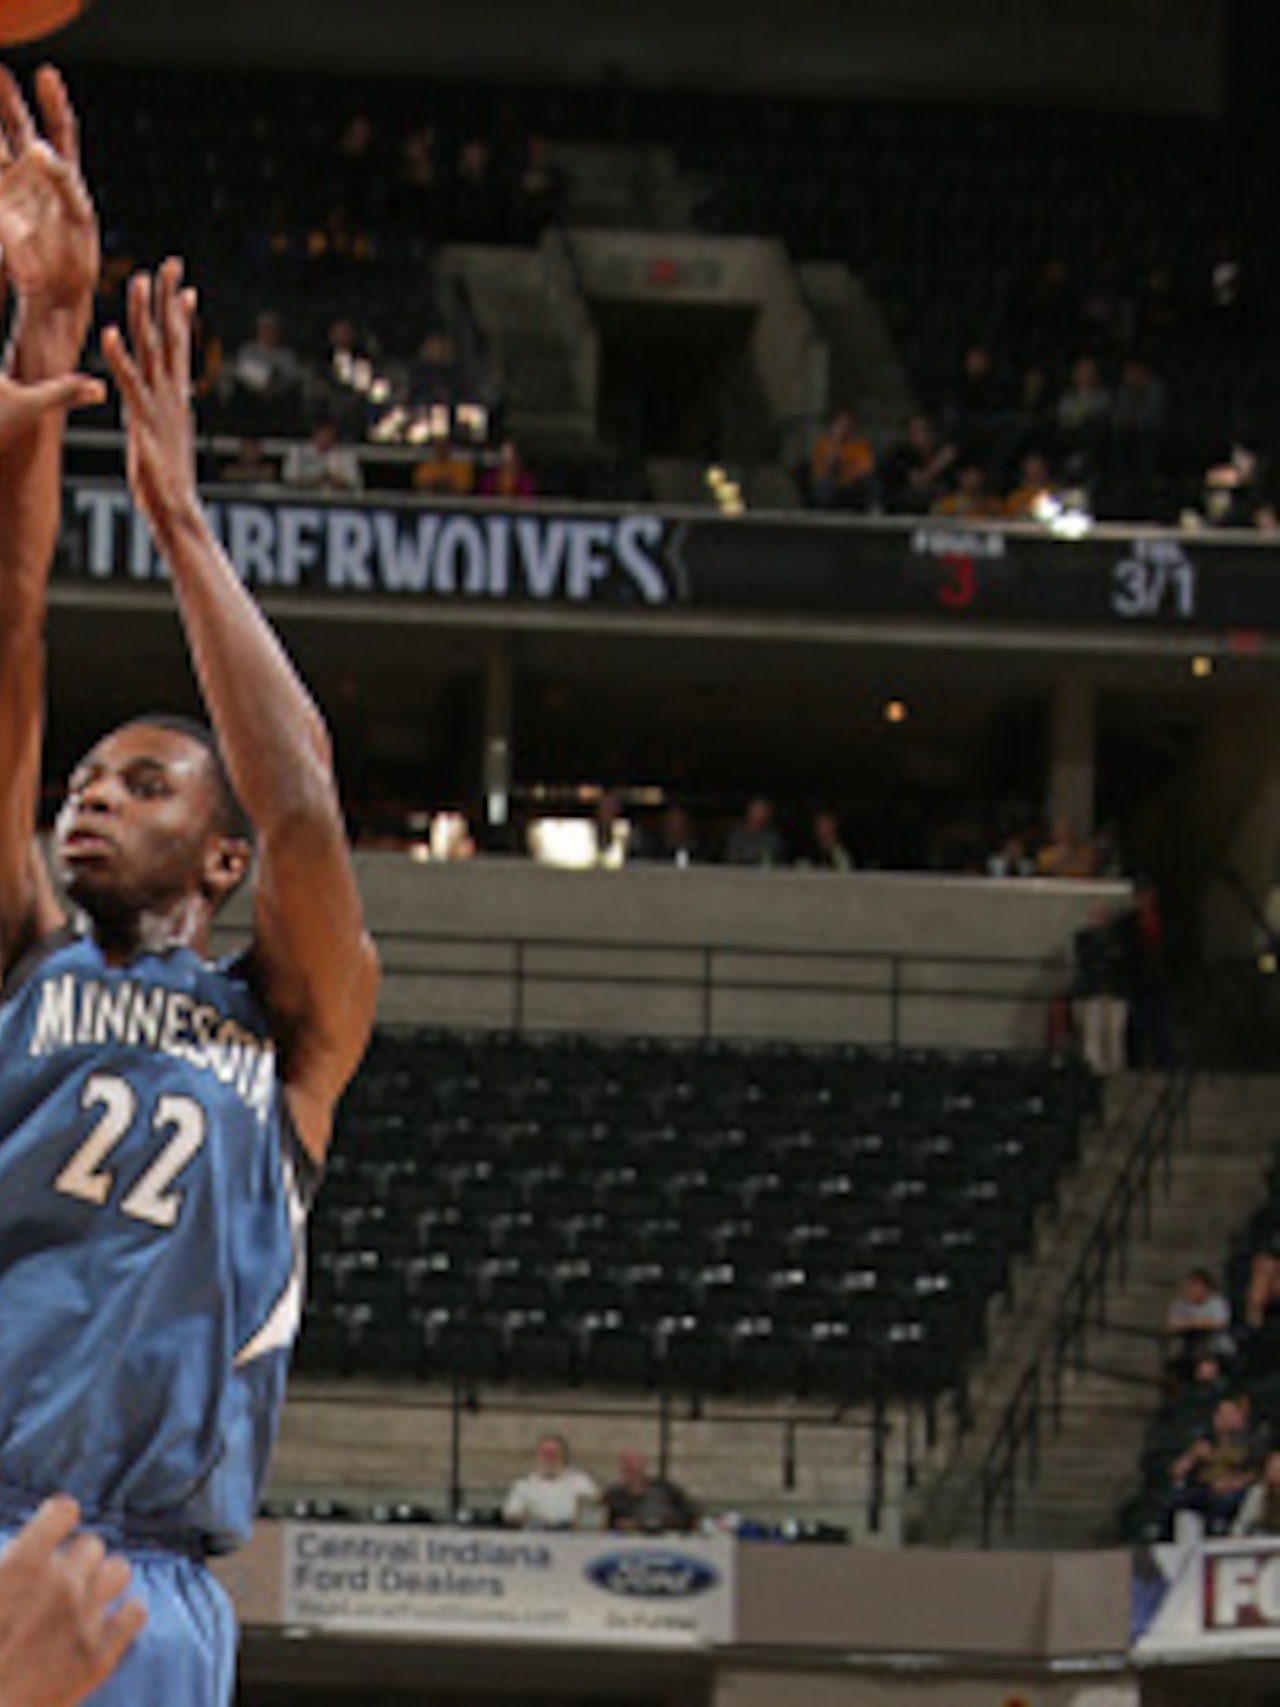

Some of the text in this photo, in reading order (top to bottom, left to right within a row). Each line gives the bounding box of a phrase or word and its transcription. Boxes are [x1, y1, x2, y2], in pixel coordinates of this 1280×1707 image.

[76, 491, 667, 604] TIBERWOLVES
[940, 553, 978, 609] 3
[1111, 558, 1195, 618] 3/1
[53, 1073, 207, 1228] 22
[294, 1533, 552, 1568] Central Indiana
[293, 1566, 505, 1598] Ford Dealers
